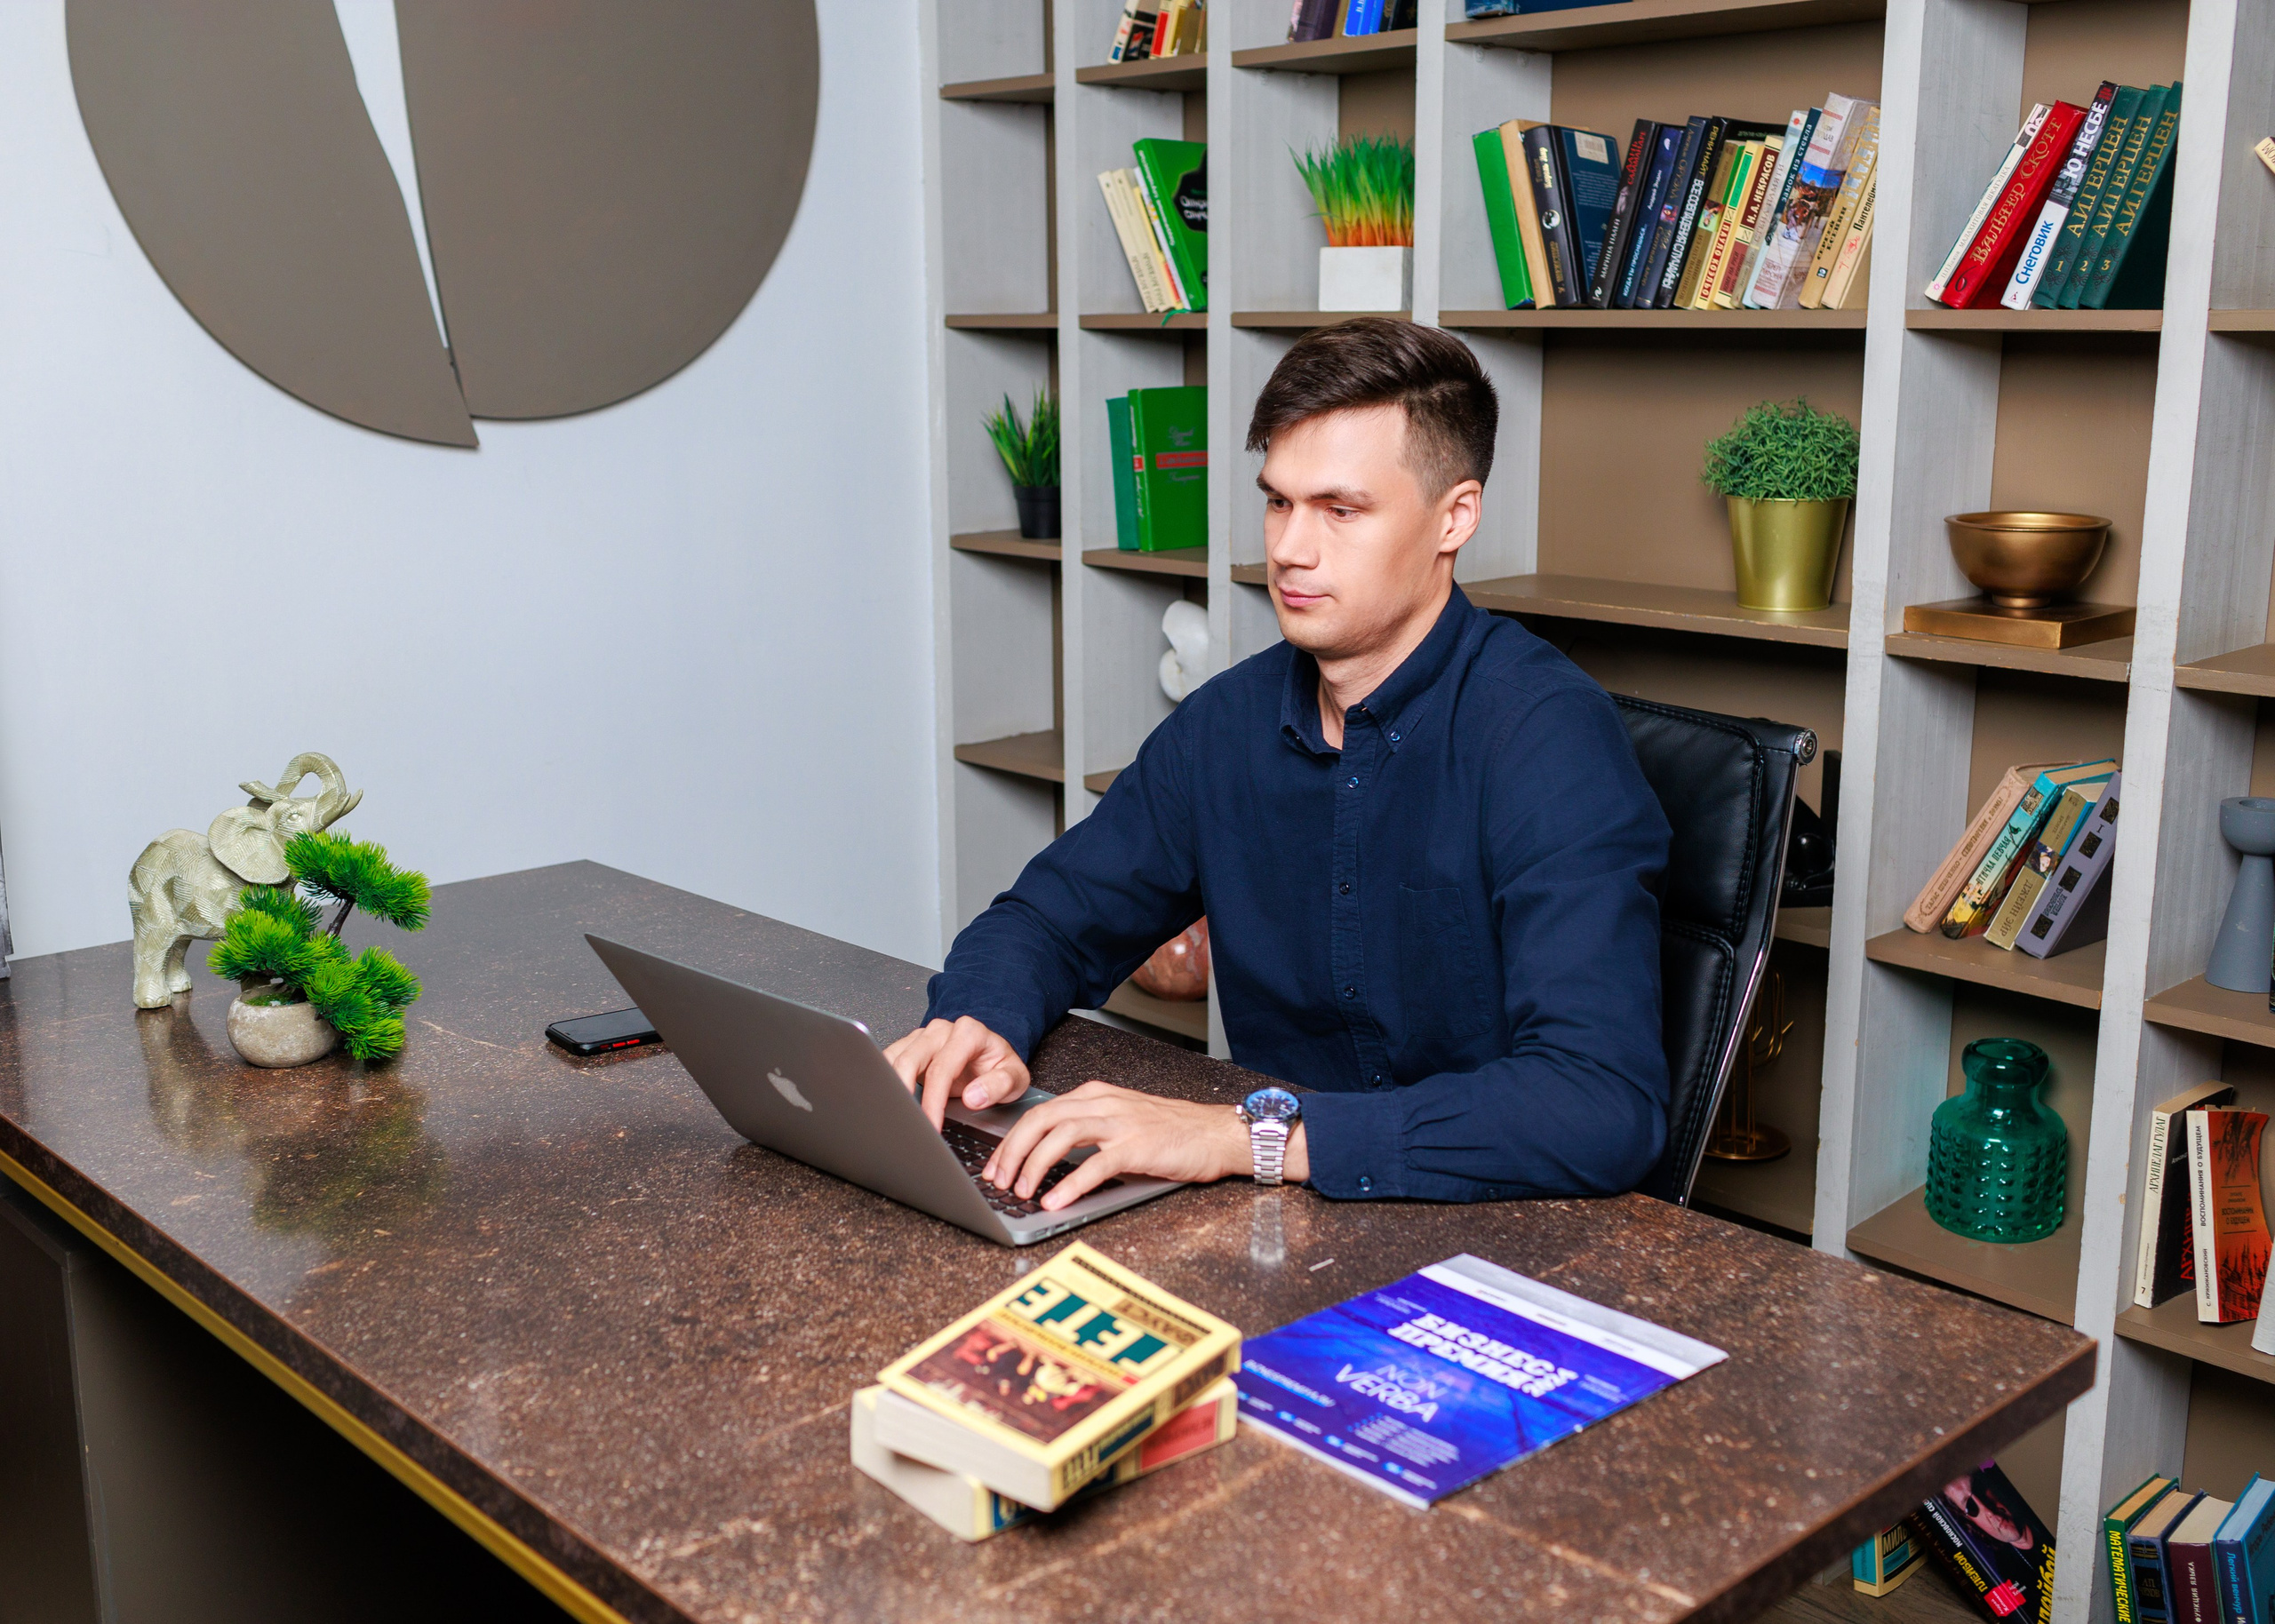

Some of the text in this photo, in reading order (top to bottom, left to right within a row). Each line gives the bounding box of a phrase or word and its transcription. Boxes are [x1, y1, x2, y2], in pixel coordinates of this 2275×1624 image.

[2063, 101, 2108, 179] Ю НЕСБЁ
[1755, 154, 1776, 198] НЕКРАСОВ
[1969, 182, 2025, 266] ВАЛЬТЕР
[2021, 116, 2062, 181] СКОТТ
[1853, 180, 1877, 231] Пантелеймо
[1718, 222, 1731, 256] ПАУЛО
[1702, 257, 1720, 298] КОЭЛЬО
[2055, 259, 2064, 273] 1
[2079, 259, 2089, 273] 2
[2100, 259, 2111, 271] 3
[2149, 1116, 2166, 1194] АРХИПЕЛАГ ГУЛАГ
[1335, 1363, 1440, 1423] VERBA
[1375, 1364, 1448, 1401] NON
[2109, 1530, 2131, 1624] МАТЕМАТИЧЕСКИЕ
